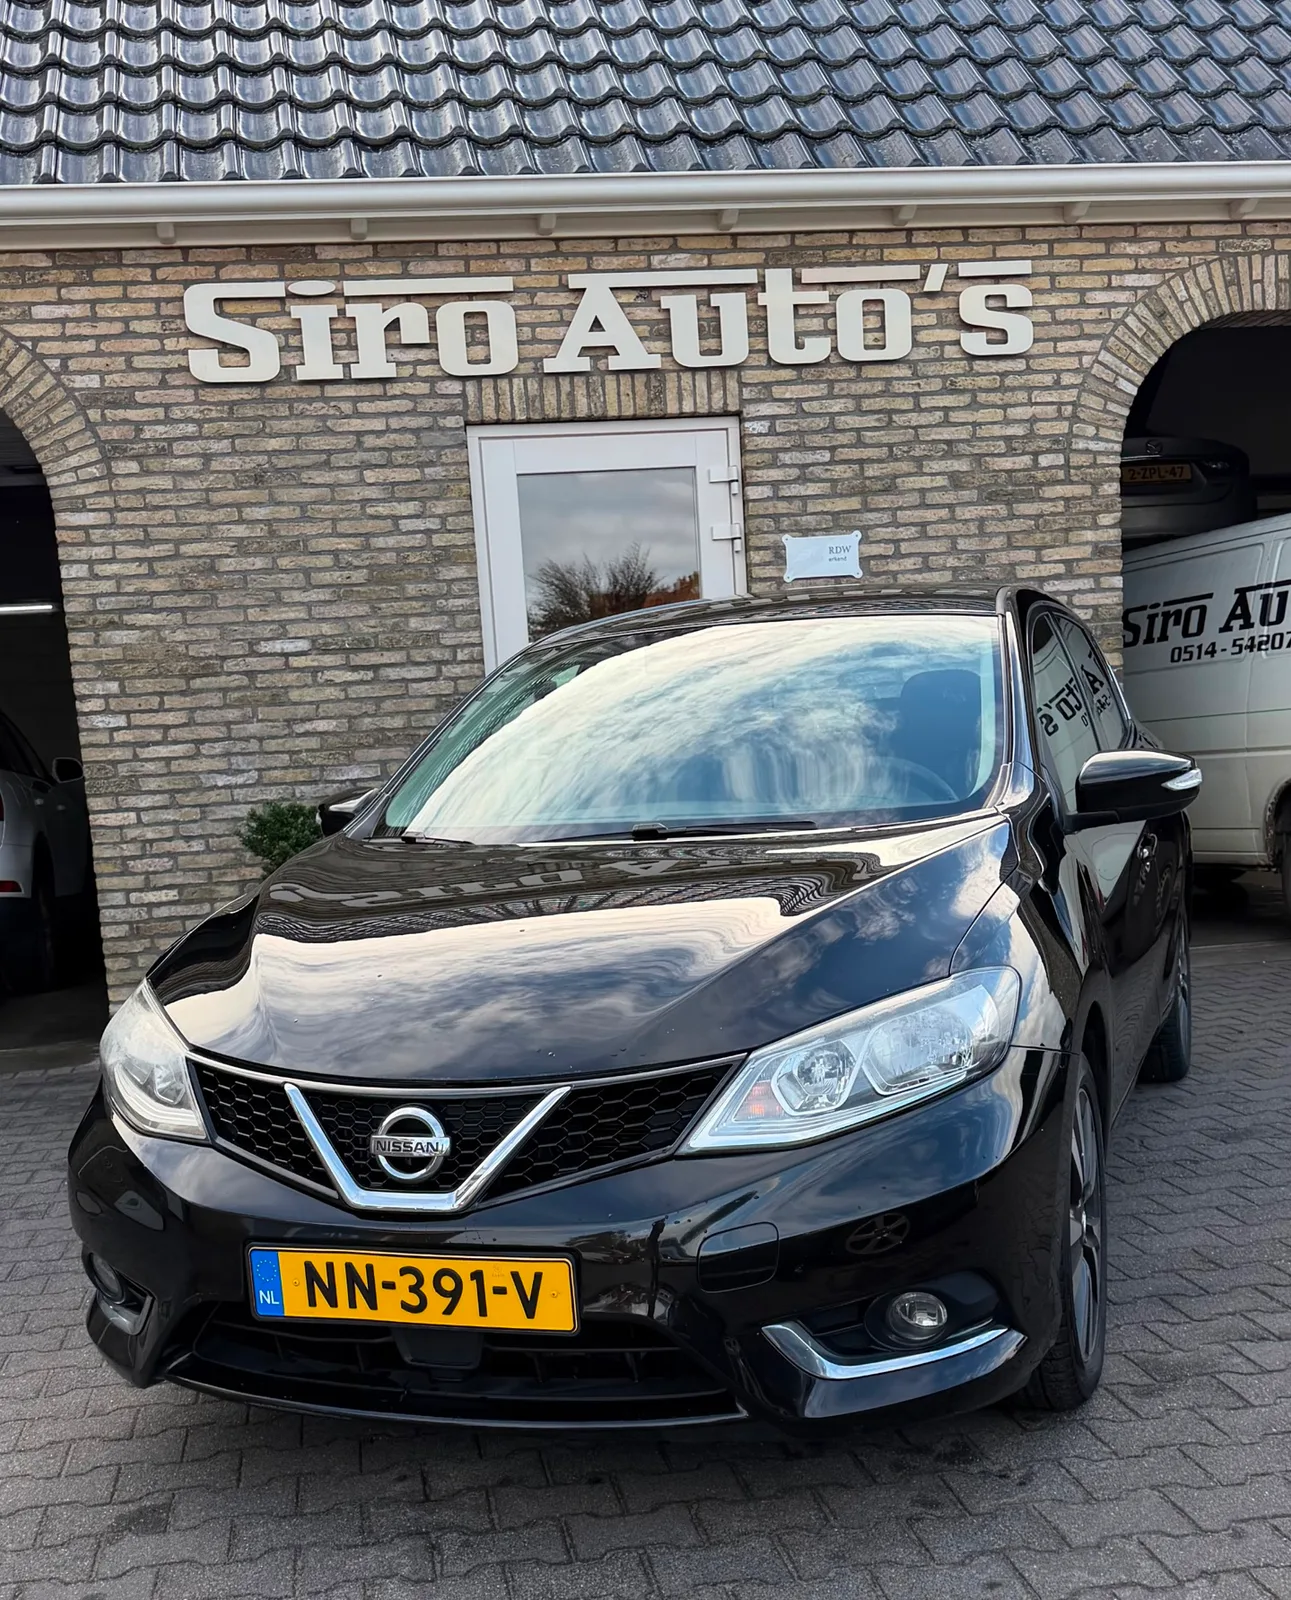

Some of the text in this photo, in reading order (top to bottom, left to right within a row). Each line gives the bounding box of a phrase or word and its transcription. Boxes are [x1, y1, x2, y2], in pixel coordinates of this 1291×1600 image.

[183, 260, 1035, 384] Siro Auto's
[1128, 466, 1184, 480] 2-ZPL-47
[828, 545, 852, 555] RDW
[1122, 592, 1214, 649] Siro
[376, 1141, 440, 1153] NISSAN
[259, 1289, 280, 1305] NL
[304, 1260, 543, 1319] NN-391-V
